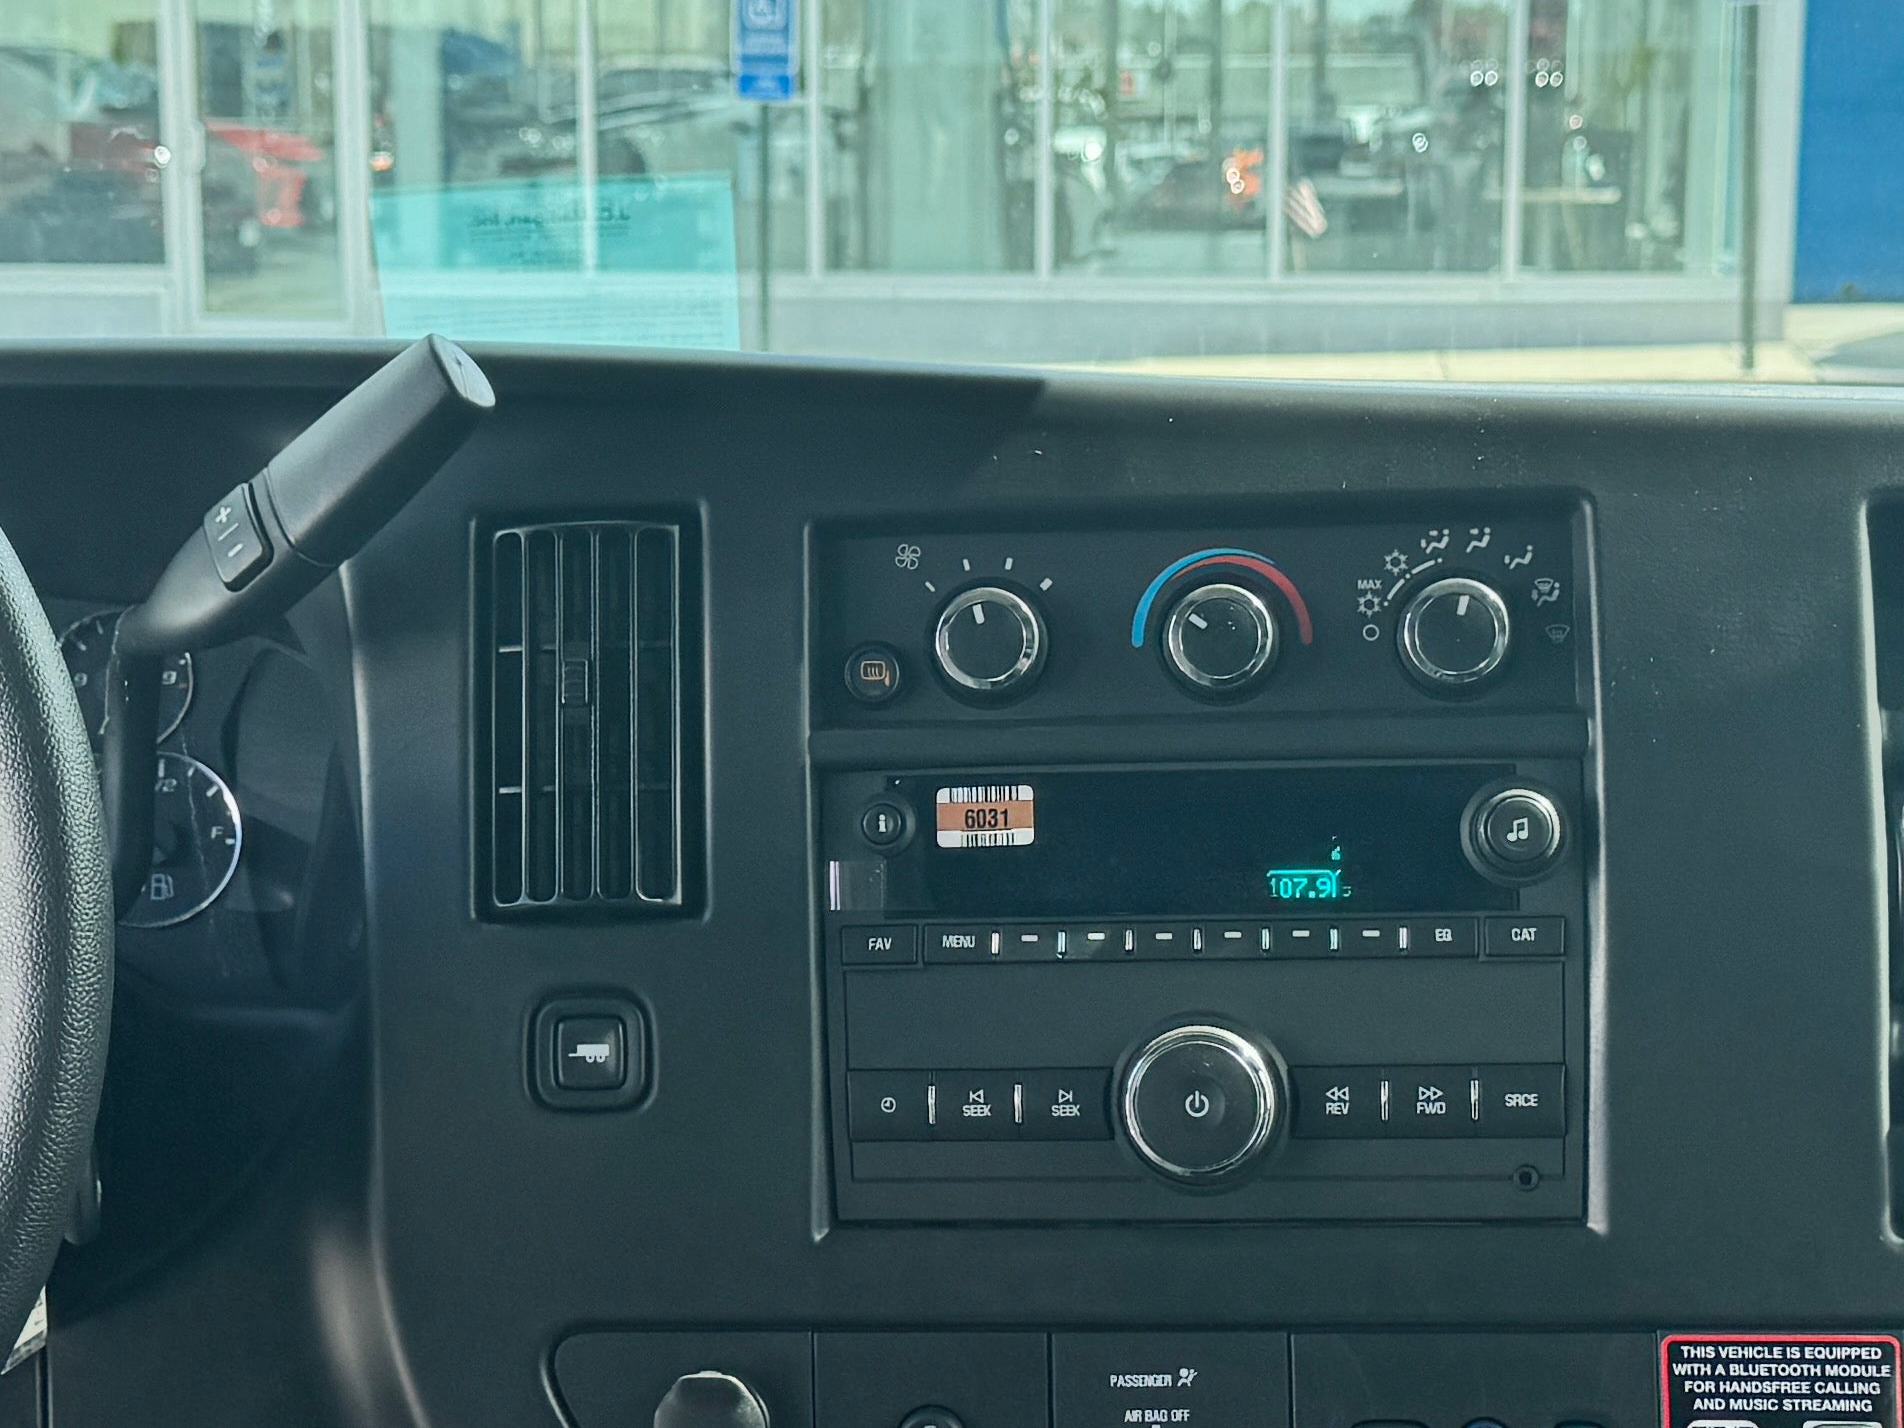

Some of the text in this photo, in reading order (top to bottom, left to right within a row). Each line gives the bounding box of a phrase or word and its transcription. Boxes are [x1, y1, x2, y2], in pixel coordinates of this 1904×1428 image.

[1356, 578, 1384, 591] MAX
[963, 807, 1010, 830] 6031
[210, 826, 224, 839] F
[942, 934, 976, 948] MENU
[1434, 928, 1453, 942] EQ
[1511, 928, 1537, 942] CAT
[868, 937, 892, 951] FAV
[1504, 1093, 1538, 1108] SRCE
[962, 1104, 992, 1117] SEEK
[1051, 1104, 1081, 1117] SEEK
[1326, 1102, 1350, 1116] REV
[1416, 1101, 1446, 1115] FWD
[1681, 1346, 1882, 1360] THIS VEHICLE IS EQUIPPED
[1673, 1363, 1891, 1378] WITH A BLUETOOTH MODULE
[1110, 1374, 1172, 1388] PASSENGER
[1684, 1380, 1880, 1395] FOR HANDSFREE CALLING
[1694, 1398, 1873, 1412] AND MUSIC STREAMING
[1124, 1408, 1190, 1422] AIR BAG OFF
